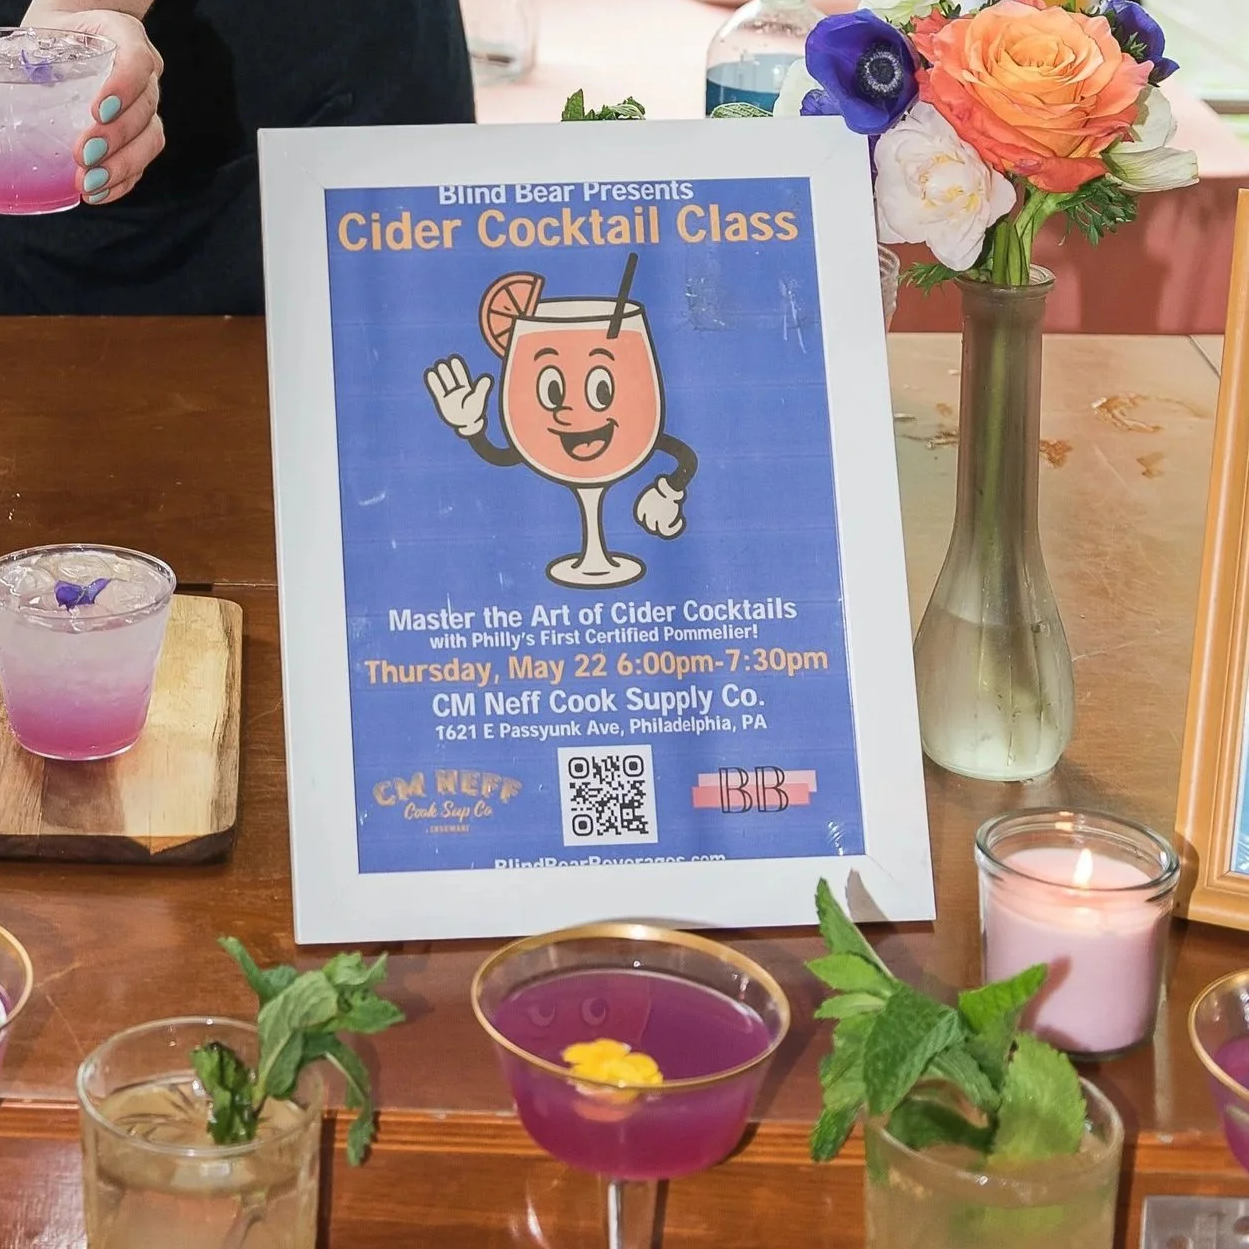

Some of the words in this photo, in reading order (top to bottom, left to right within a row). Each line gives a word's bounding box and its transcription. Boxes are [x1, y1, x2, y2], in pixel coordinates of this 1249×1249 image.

[439, 184, 506, 204] Blind
[516, 183, 574, 202] Bear
[583, 180, 693, 201] Presents
[338, 210, 462, 251] Cider
[478, 205, 659, 247] Cocktail
[677, 204, 799, 242] Class
[389, 608, 475, 631] Master
[483, 607, 522, 628] the
[531, 605, 570, 626] Art
[578, 603, 603, 625] of
[611, 601, 676, 623] Cider
[683, 598, 797, 621] Cocktails
[430, 632, 466, 649] with
[472, 630, 535, 651] Philly's
[541, 628, 580, 646] First
[585, 626, 659, 644] Certified
[664, 624, 758, 641] Pommelier!
[365, 658, 499, 687] Thursday,
[508, 655, 564, 684] May
[575, 654, 607, 677] 22
[616, 647, 829, 680] 6:00pm-7:30pm
[432, 693, 476, 717] CM
[485, 691, 541, 715] Neff
[549, 688, 616, 713] Cook
[626, 686, 713, 715] Supply
[722, 684, 765, 707] Co.
[436, 724, 476, 741] 1621
[484, 723, 494, 739] E
[500, 721, 582, 742] Passyunk
[587, 720, 625, 738] Ave,
[630, 716, 737, 737] Philadelphia,
[742, 714, 767, 731] PA
[373, 772, 427, 806] CM
[435, 769, 523, 803] NEFF
[718, 765, 790, 815] BB
[404, 802, 438, 820] Cook
[441, 801, 470, 822] Sup
